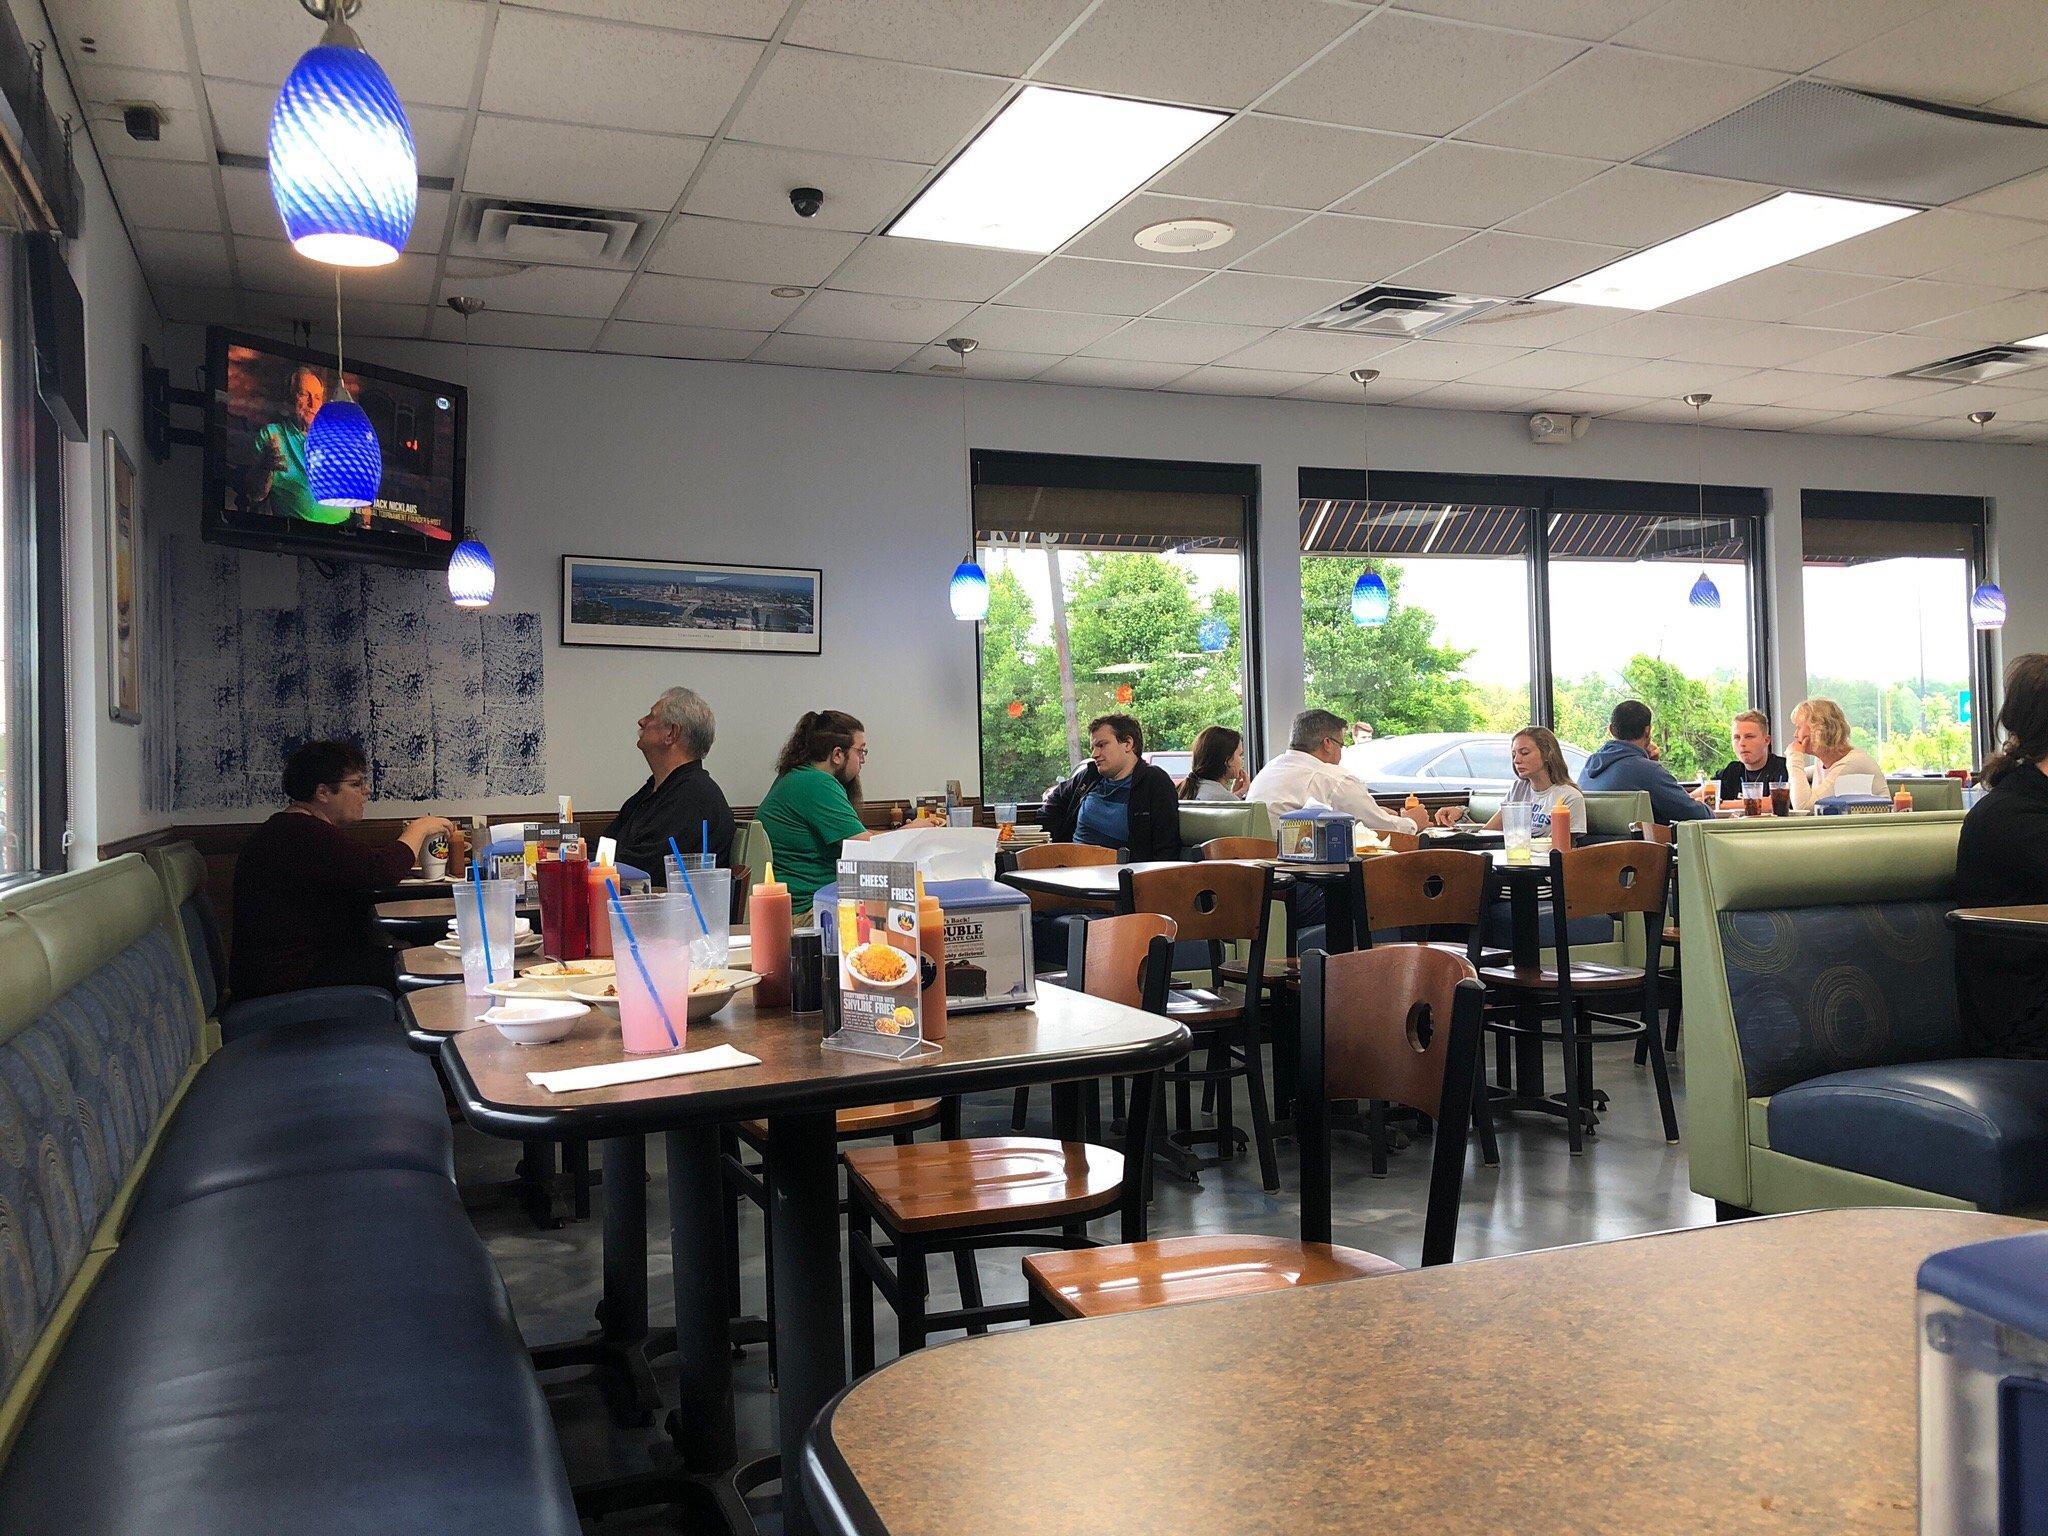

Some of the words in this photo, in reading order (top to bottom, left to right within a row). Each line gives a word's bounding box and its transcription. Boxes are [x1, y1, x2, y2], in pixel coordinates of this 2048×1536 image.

[389, 501, 418, 514] NICKLAUS
[1532, 803, 1544, 813] DY
[838, 861, 858, 875] CHILI
[860, 874, 889, 888] CHEESE
[891, 888, 914, 901] FRIES
[944, 924, 983, 937] UBLE
[843, 998, 873, 1013] SKYLINE
[874, 1002, 896, 1015] FRIES
